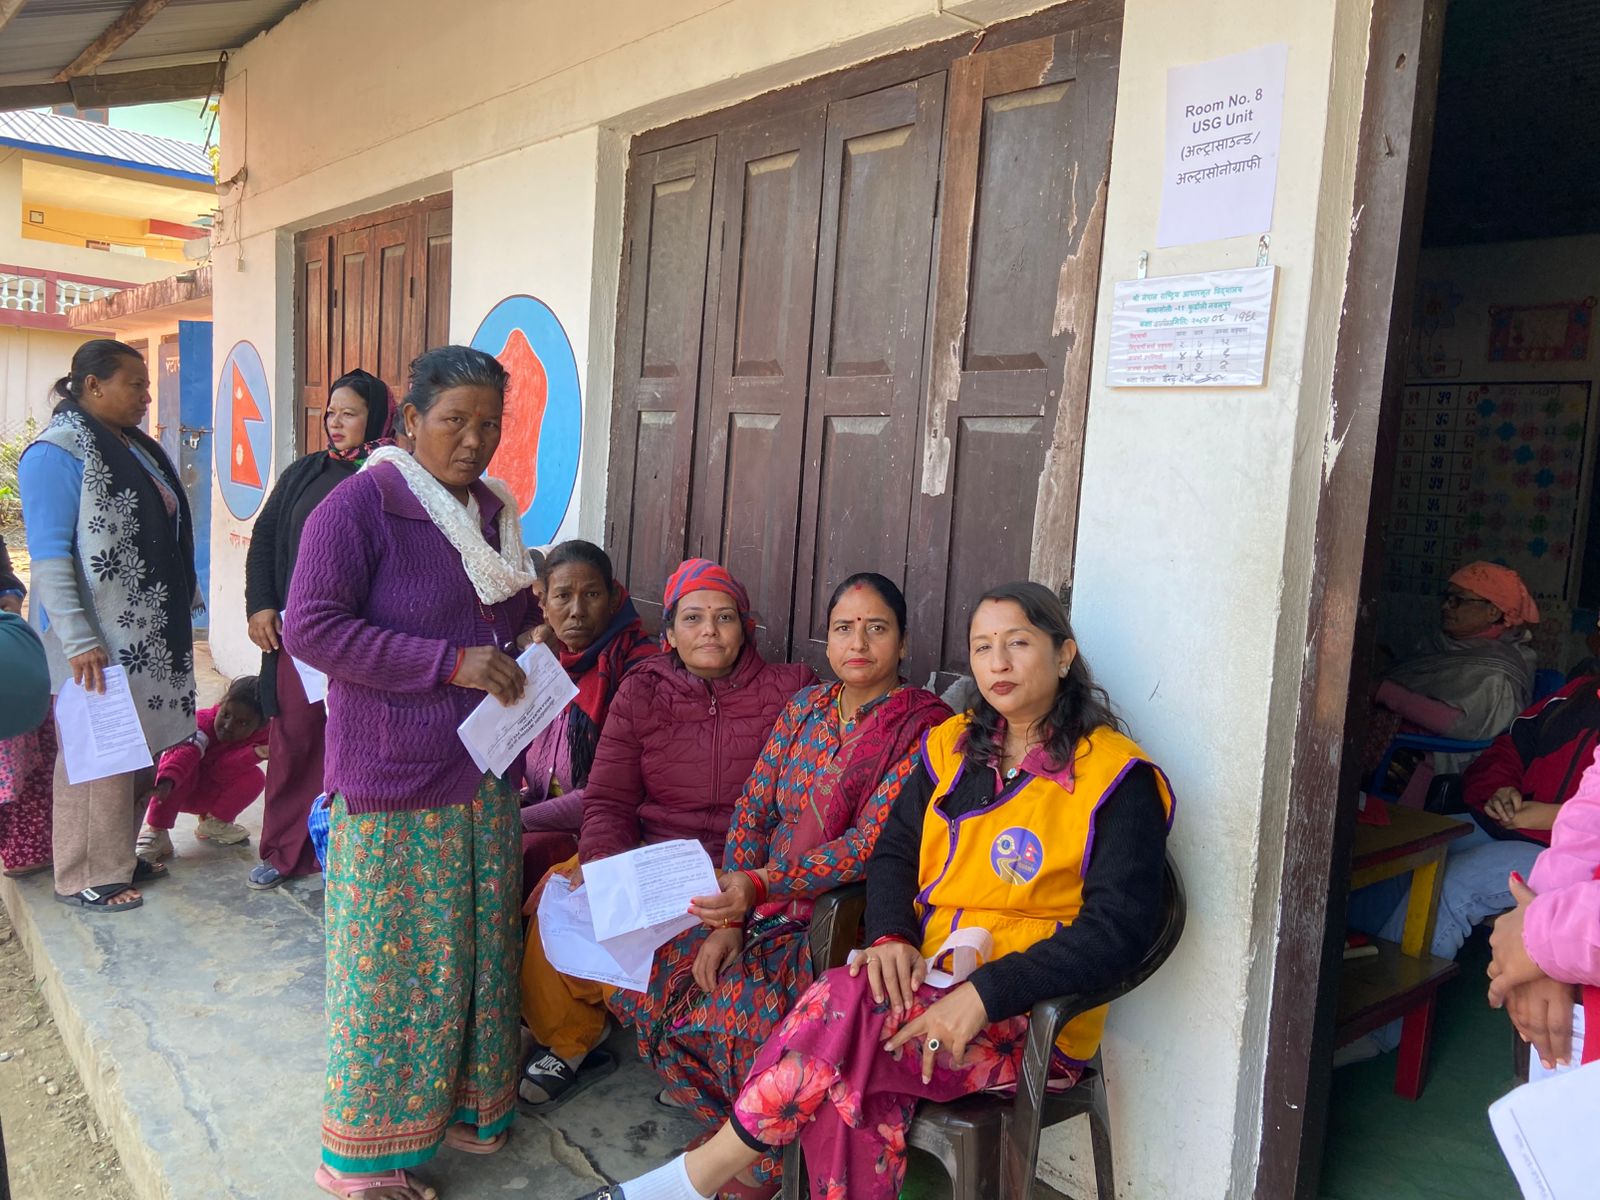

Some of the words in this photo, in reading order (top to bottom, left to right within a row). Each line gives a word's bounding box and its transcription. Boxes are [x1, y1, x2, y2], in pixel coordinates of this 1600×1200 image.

[1185, 100, 1224, 118] Room
[1228, 94, 1250, 108] No.
[1255, 88, 1263, 101] 8
[1192, 116, 1222, 134] USG
[1226, 109, 1253, 126] Unit
[1176, 154, 1262, 185] अल्ट्रासोनोग्राफी
[536, 1054, 566, 1072] NIKE
